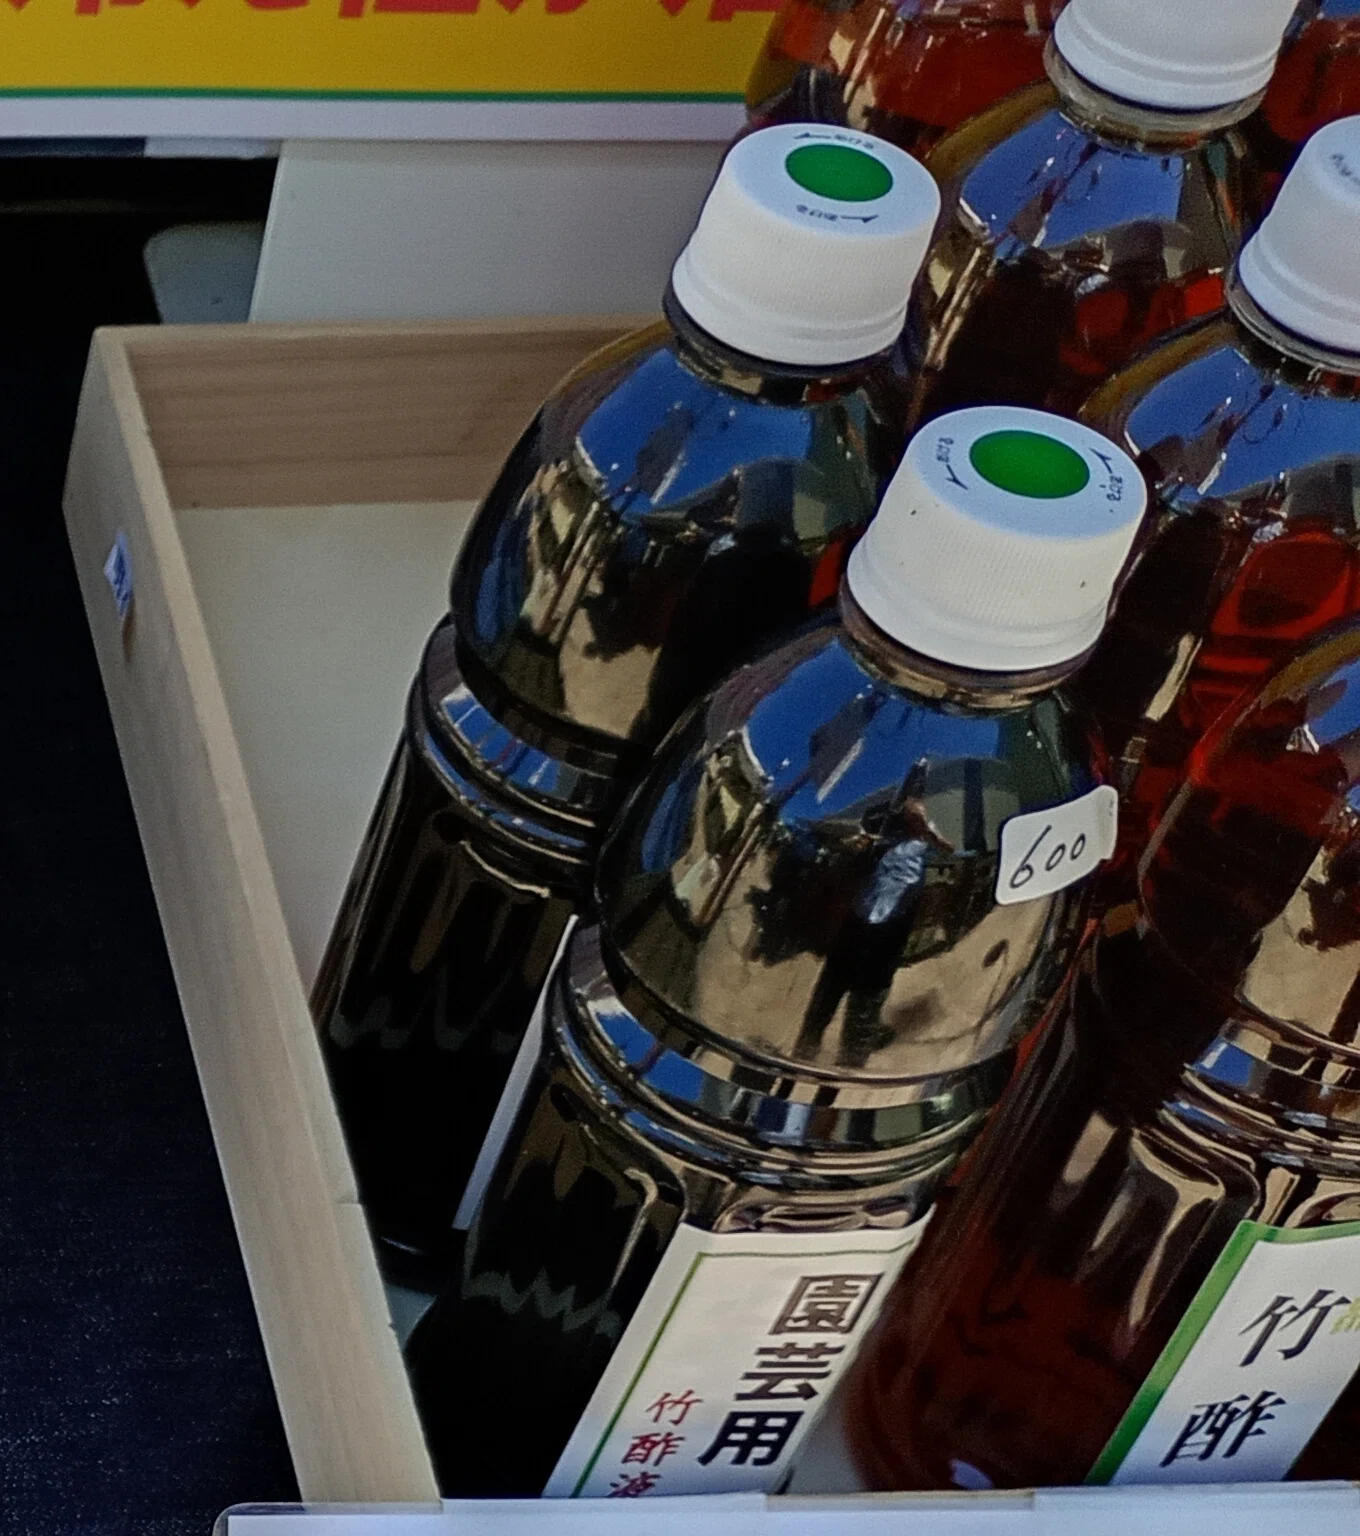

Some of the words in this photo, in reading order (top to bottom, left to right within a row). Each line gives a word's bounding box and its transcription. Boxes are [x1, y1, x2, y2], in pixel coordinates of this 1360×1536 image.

[1010, 824, 1087, 890] 600
[697, 1272, 885, 1467] 園芸用
